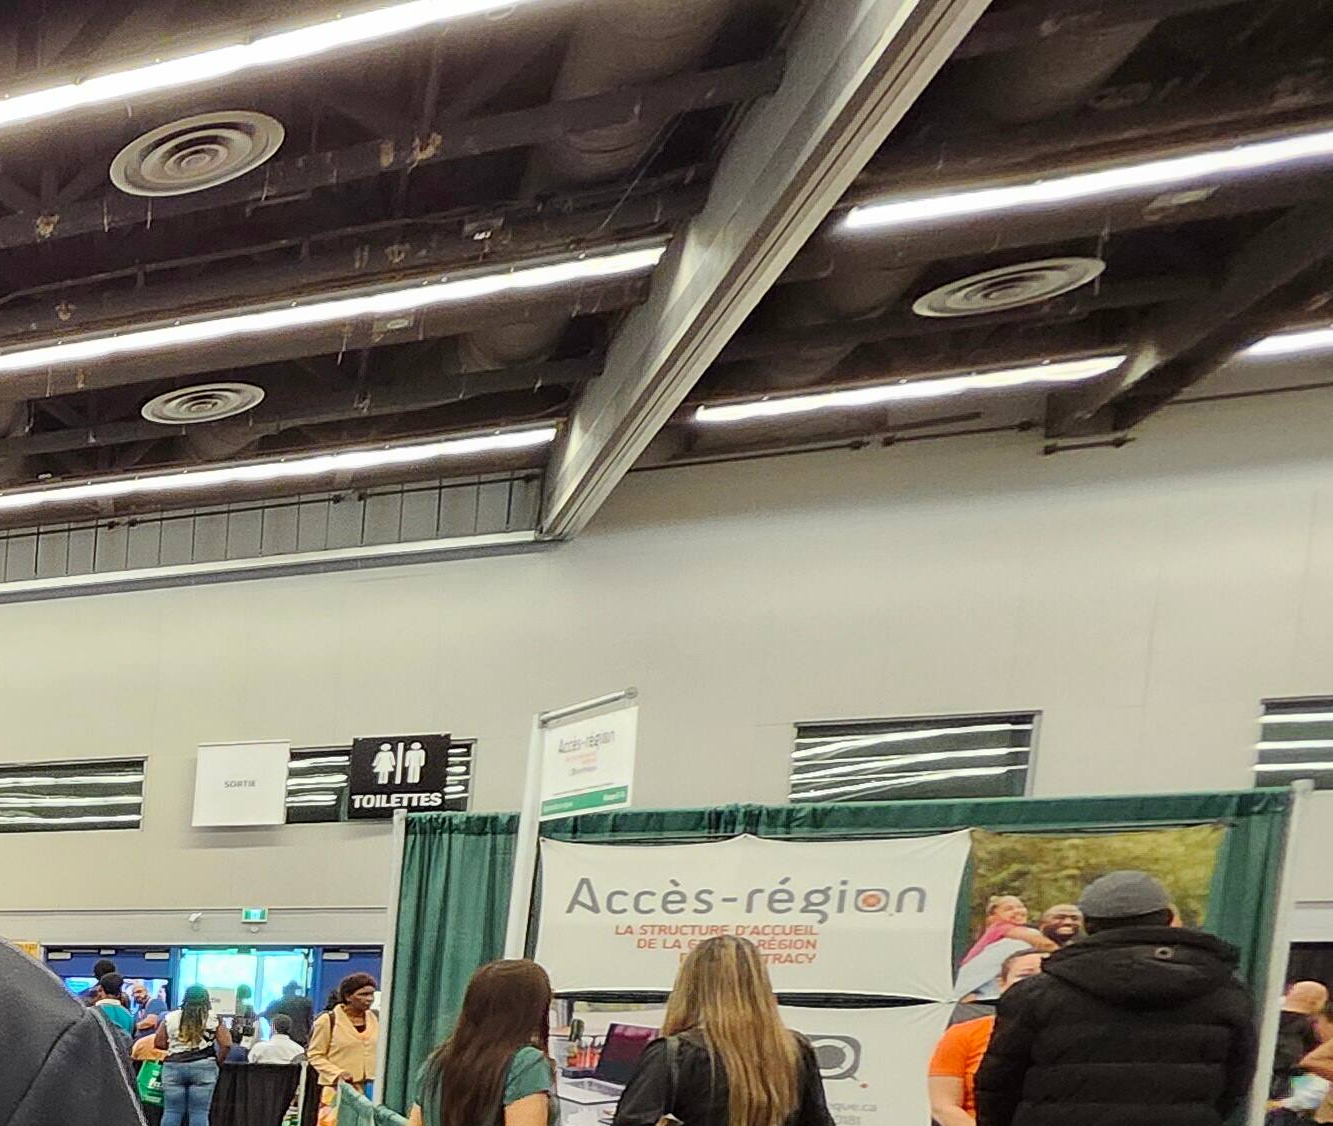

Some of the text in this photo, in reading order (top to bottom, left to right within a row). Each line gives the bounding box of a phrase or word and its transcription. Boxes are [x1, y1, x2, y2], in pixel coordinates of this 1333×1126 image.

[223, 779, 256, 788] SORTIE
[351, 792, 443, 809] TOILETTES
[565, 877, 927, 925] Accès-région
[614, 924, 818, 936] LA STRUCTURE D'ACCUEIL
[636, 938, 658, 949] DE
[662, 938, 682, 949] LA
[756, 936, 817, 950] RÉGION
[762, 953, 816, 965] TRACY
